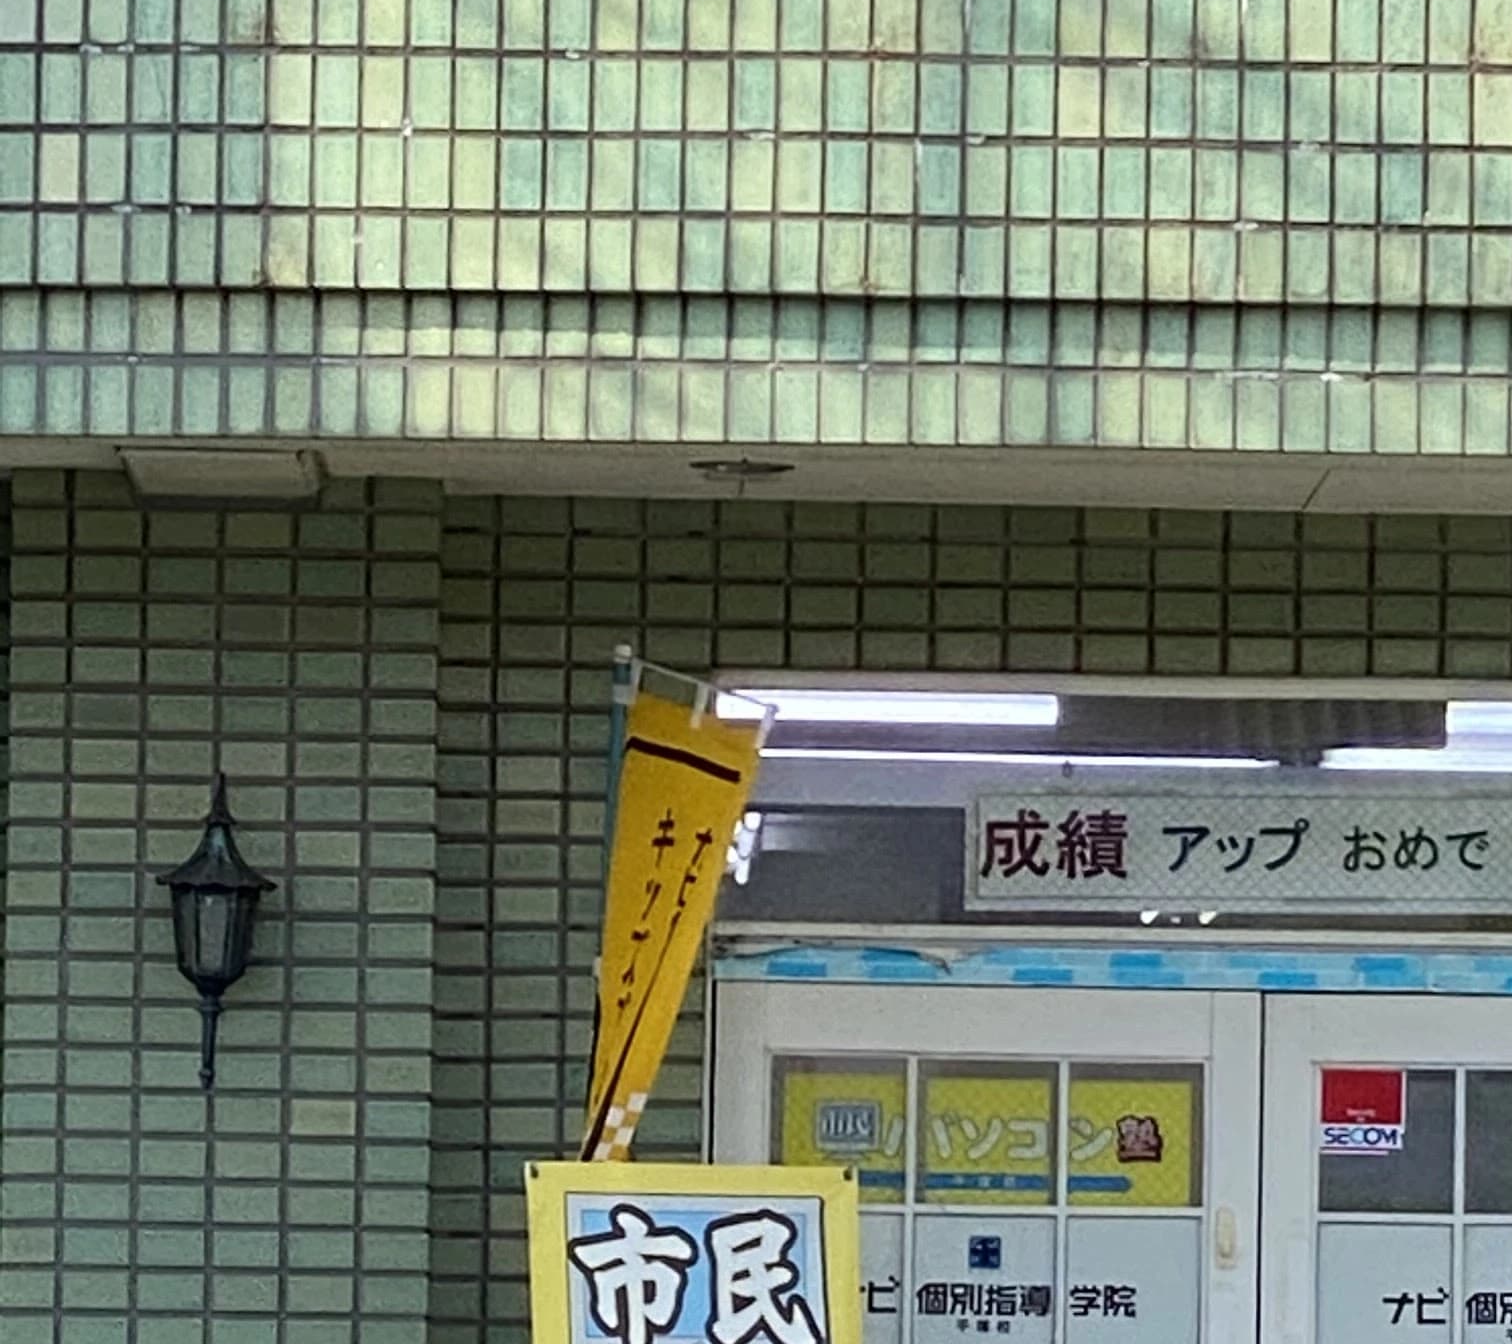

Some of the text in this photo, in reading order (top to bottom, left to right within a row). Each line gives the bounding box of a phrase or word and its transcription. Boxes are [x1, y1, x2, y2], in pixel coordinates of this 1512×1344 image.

[1323, 1126, 1398, 1146] SECOM
[861, 1277, 1137, 1318] ビ個別指導学院
